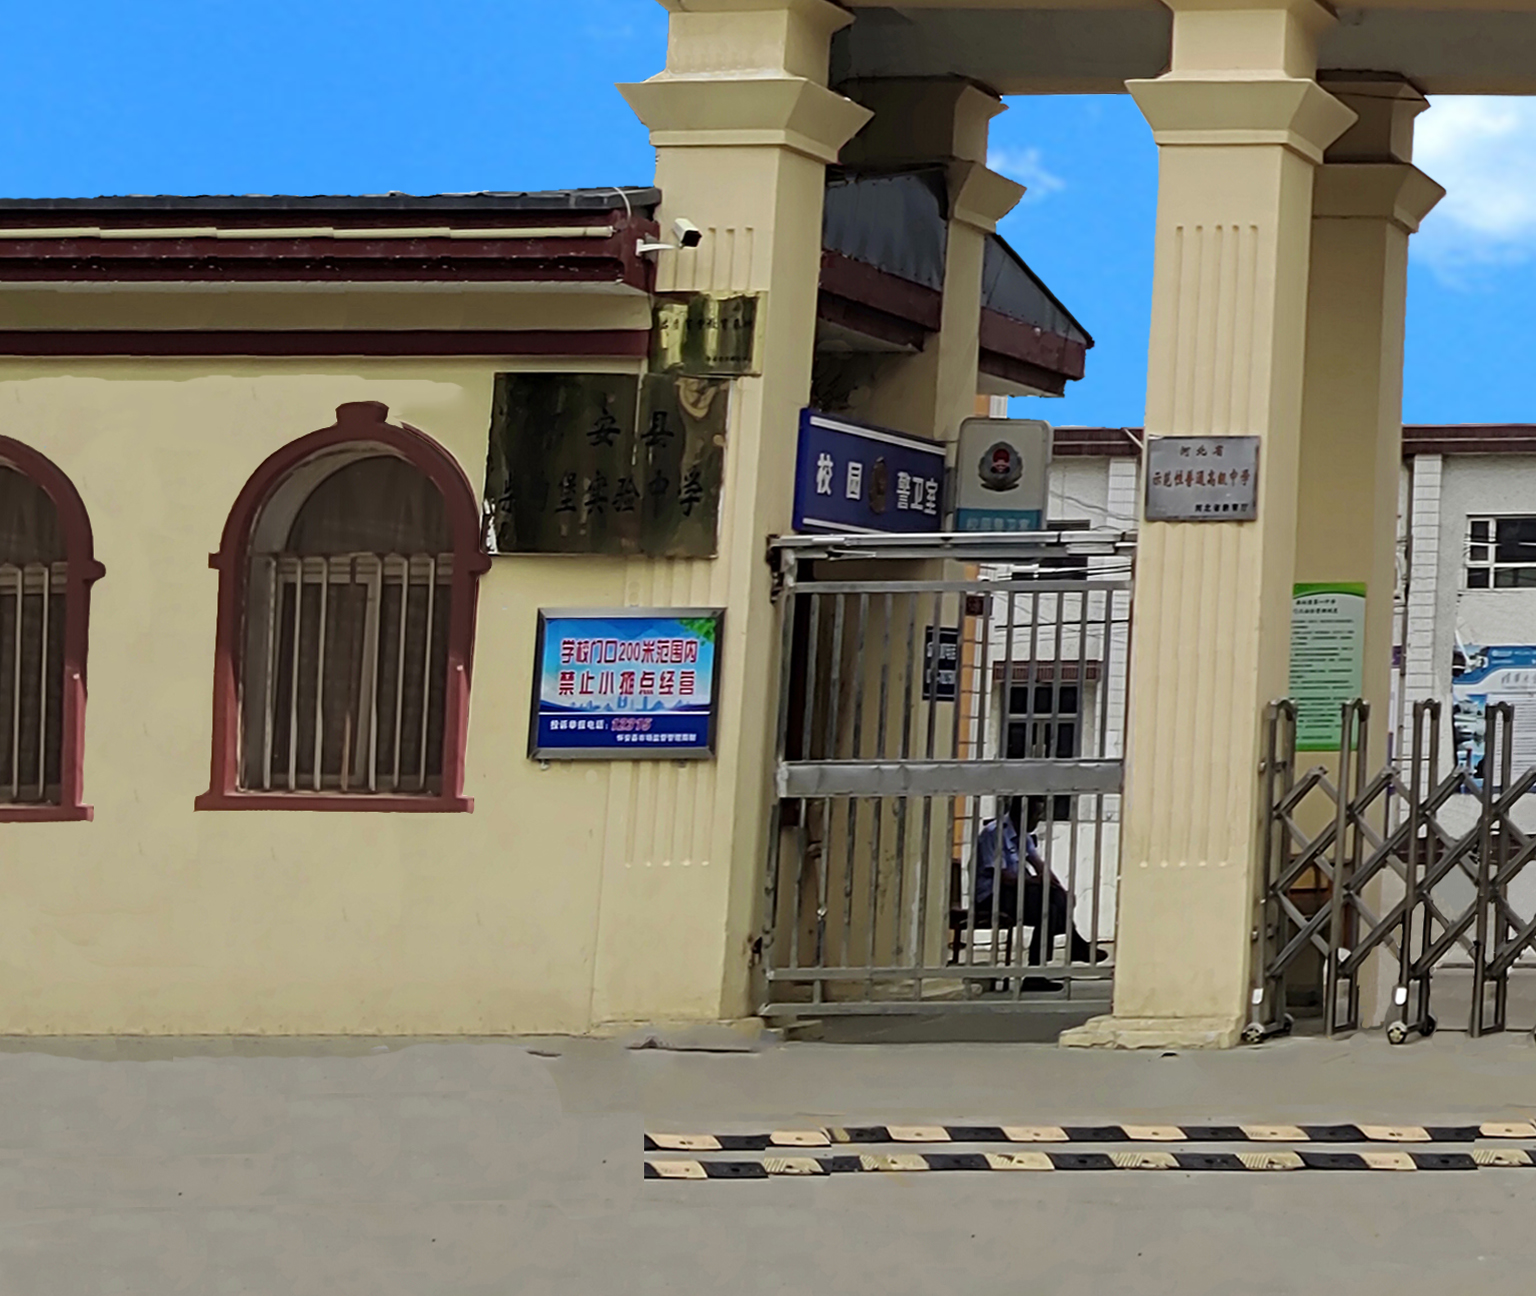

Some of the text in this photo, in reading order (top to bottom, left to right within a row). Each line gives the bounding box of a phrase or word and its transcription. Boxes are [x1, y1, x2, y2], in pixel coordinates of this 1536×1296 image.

[1180, 445, 1224, 457] 河北省
[1152, 468, 1250, 487] 示范性普通高级中学
[497, 468, 703, 517] 柴堡实验中学
[561, 639, 698, 664] 学校门口200米范围内
[559, 670, 696, 695] 禁止小摊点经营
